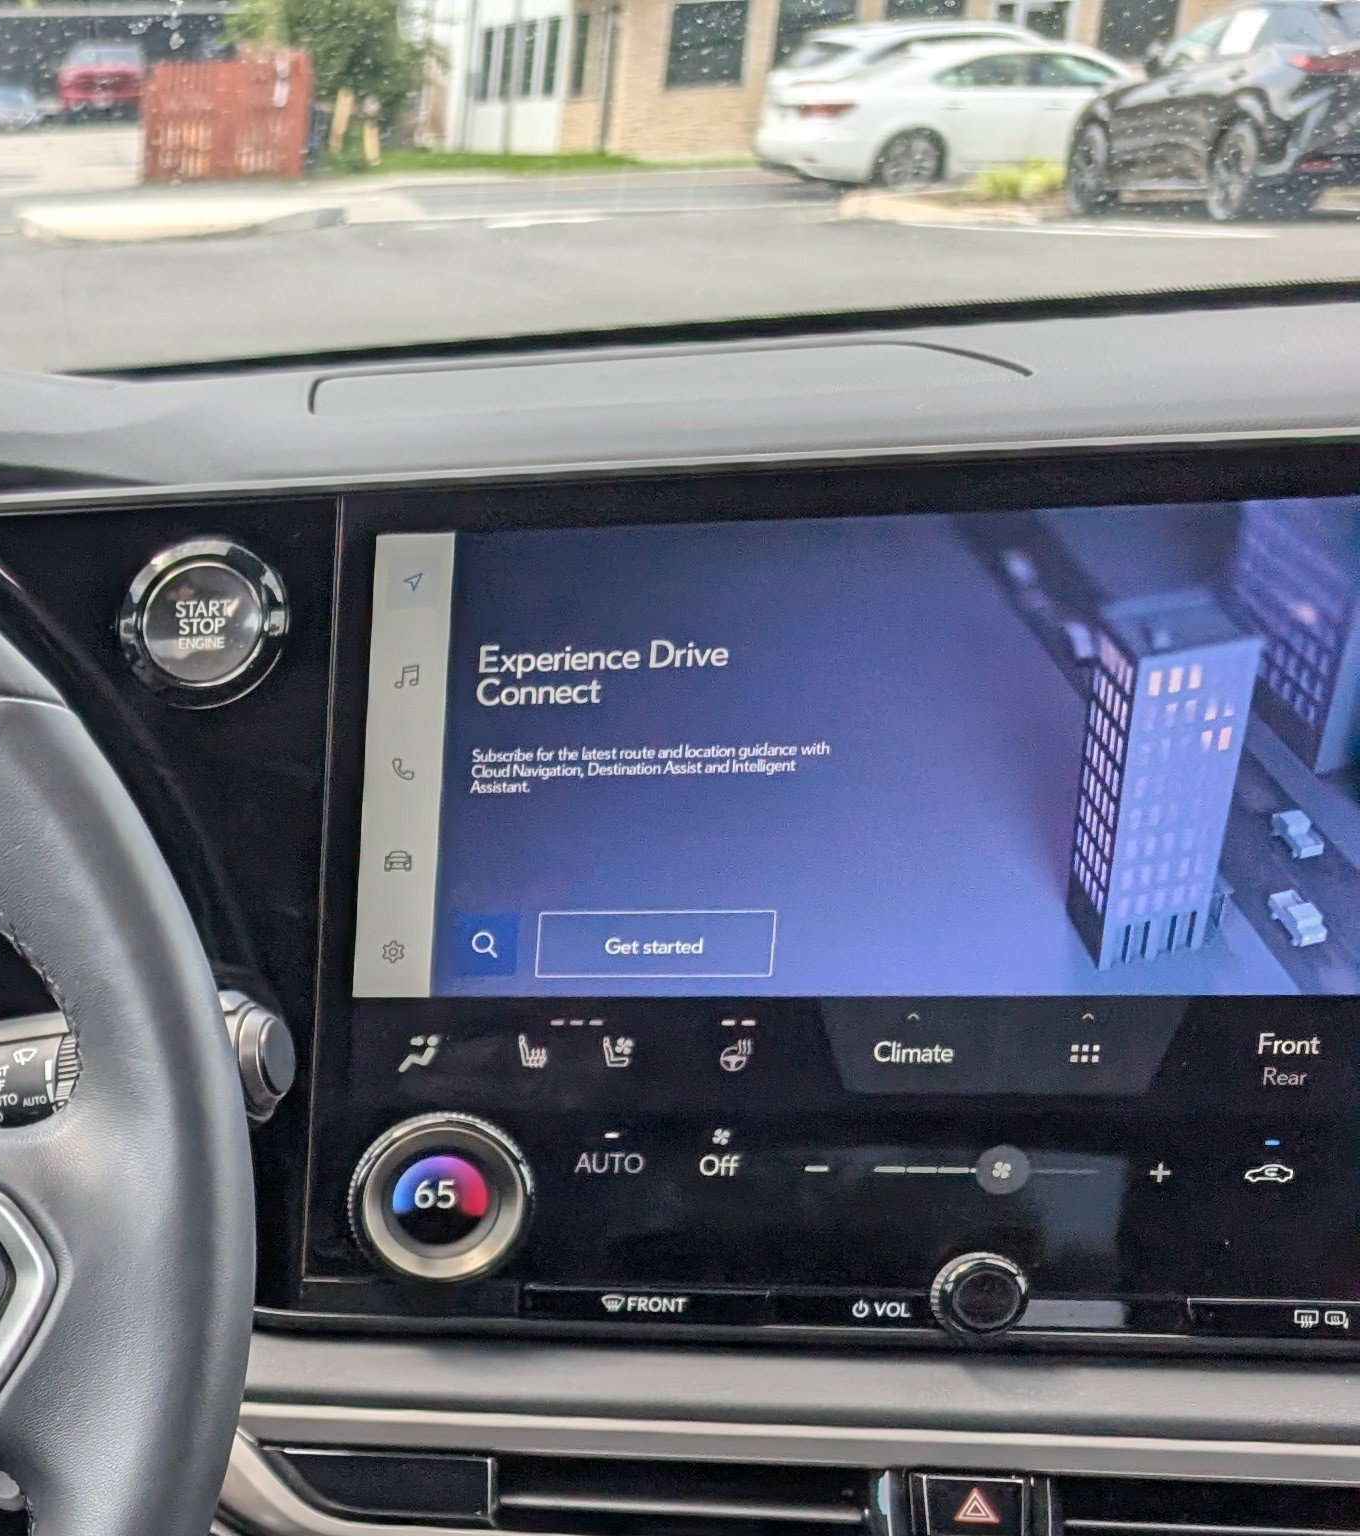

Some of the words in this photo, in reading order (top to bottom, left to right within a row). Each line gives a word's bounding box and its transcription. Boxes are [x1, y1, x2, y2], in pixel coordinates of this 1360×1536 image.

[174, 600, 232, 618] START
[178, 617, 226, 635] STOP
[178, 637, 226, 650] ENGINE
[478, 644, 641, 679] Experience
[648, 639, 730, 669] Drive
[476, 678, 603, 707] Connect
[471, 748, 534, 763] Subscribe
[536, 747, 555, 762] for
[558, 746, 579, 761] the
[582, 746, 618, 761] latest
[619, 747, 656, 760] route
[657, 744, 682, 759] and
[684, 743, 736, 758] location
[738, 742, 797, 760] guidance
[801, 741, 831, 756] with
[471, 763, 510, 778] Cloud
[512, 763, 585, 780] Navigation,
[587, 761, 661, 776] Destination
[663, 760, 702, 775] Assist
[704, 759, 730, 774] and
[732, 758, 796, 776] Intelligent
[469, 780, 530, 794] Assistant.
[604, 937, 640, 955] Get
[642, 937, 705, 955] started
[872, 1040, 955, 1065] Climate
[1256, 1032, 1321, 1057] Front
[1262, 1067, 1308, 1087] Rear
[22, 1095, 48, 1107] AUTO
[574, 1152, 645, 1175] AUTO
[699, 1152, 741, 1177] Off
[413, 1179, 458, 1211] 65
[626, 1295, 688, 1314] FRONT
[874, 1301, 911, 1319] VOL
